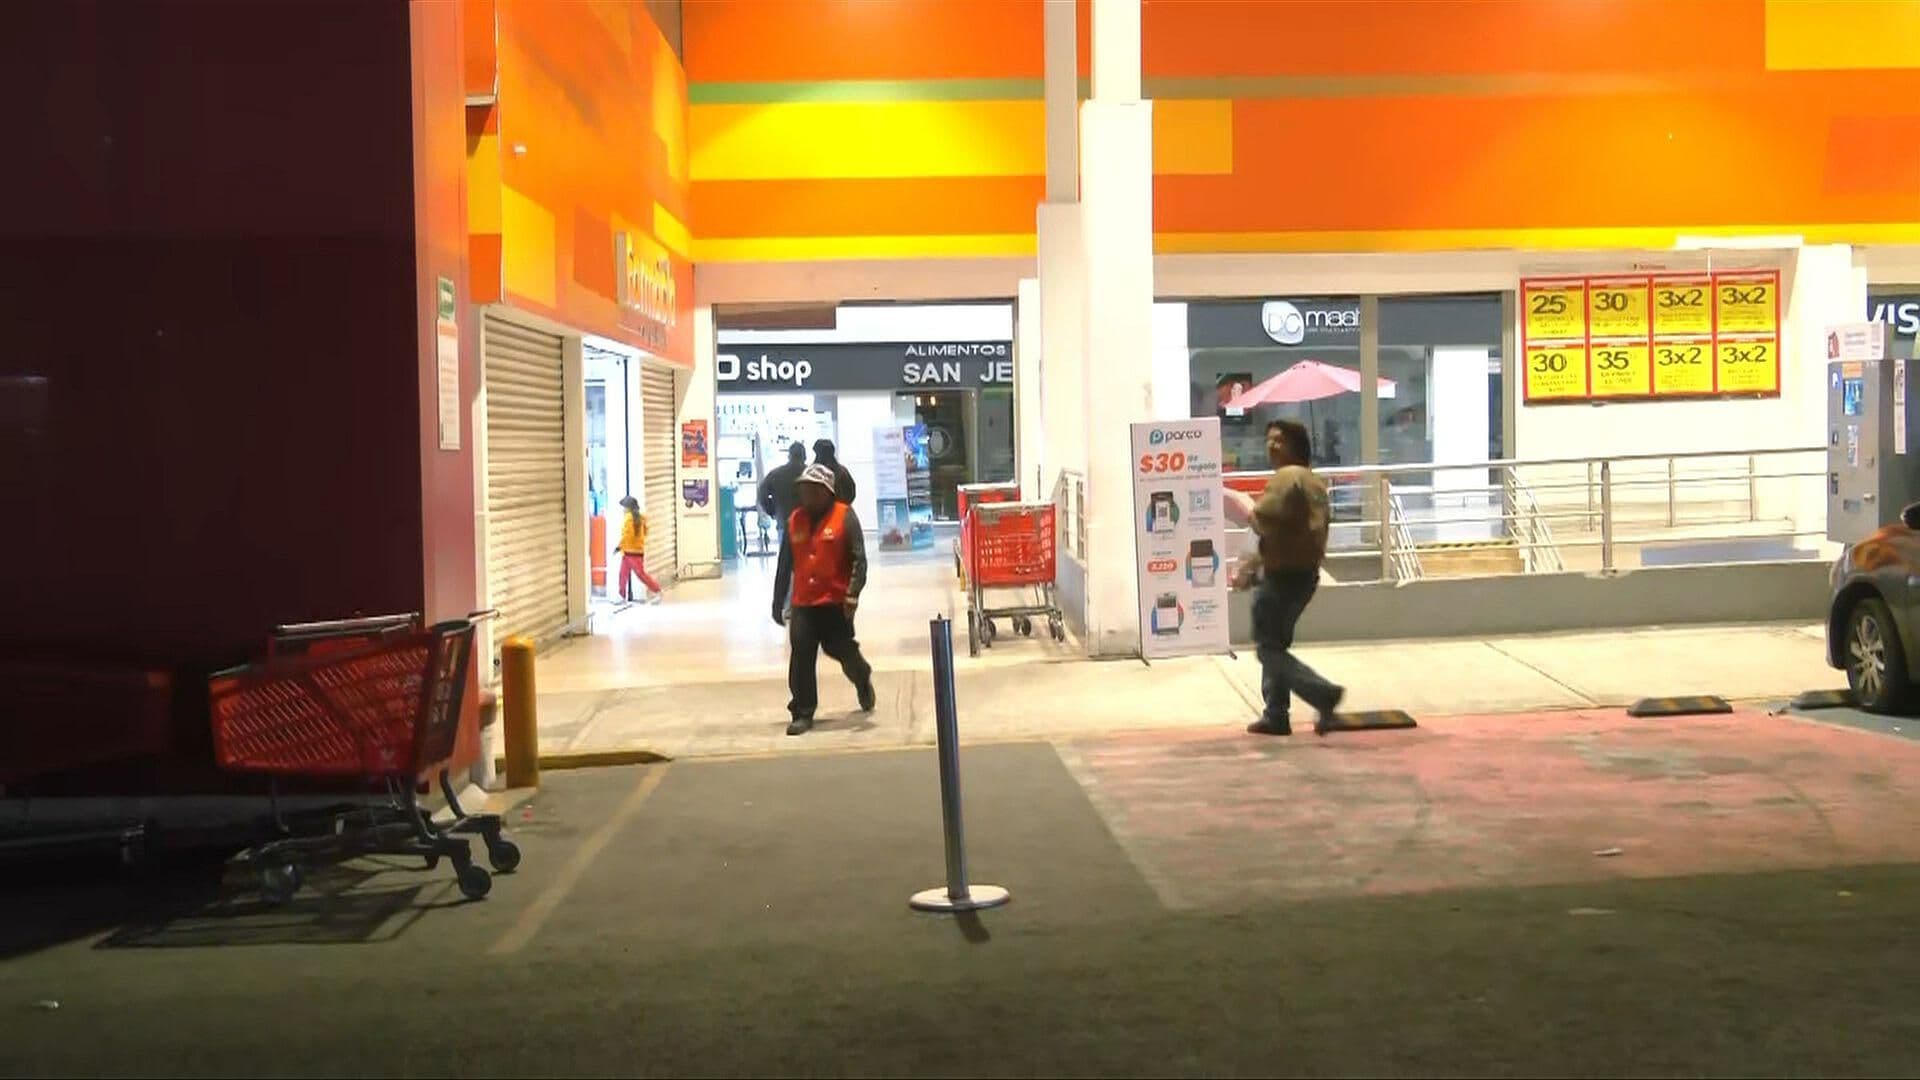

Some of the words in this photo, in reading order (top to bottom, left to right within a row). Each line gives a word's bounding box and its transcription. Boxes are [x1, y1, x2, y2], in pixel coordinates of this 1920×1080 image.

[1658, 289, 1703, 308] 3x2
[1722, 287, 1766, 305] 3x2
[905, 344, 1006, 356] ALIMENTOS
[1657, 347, 1702, 366] 3x2
[1723, 345, 1767, 364] 3x2
[746, 354, 812, 386] shop
[903, 362, 960, 384] SAN
[980, 361, 1012, 382] JE
[1140, 451, 1185, 473] $30
